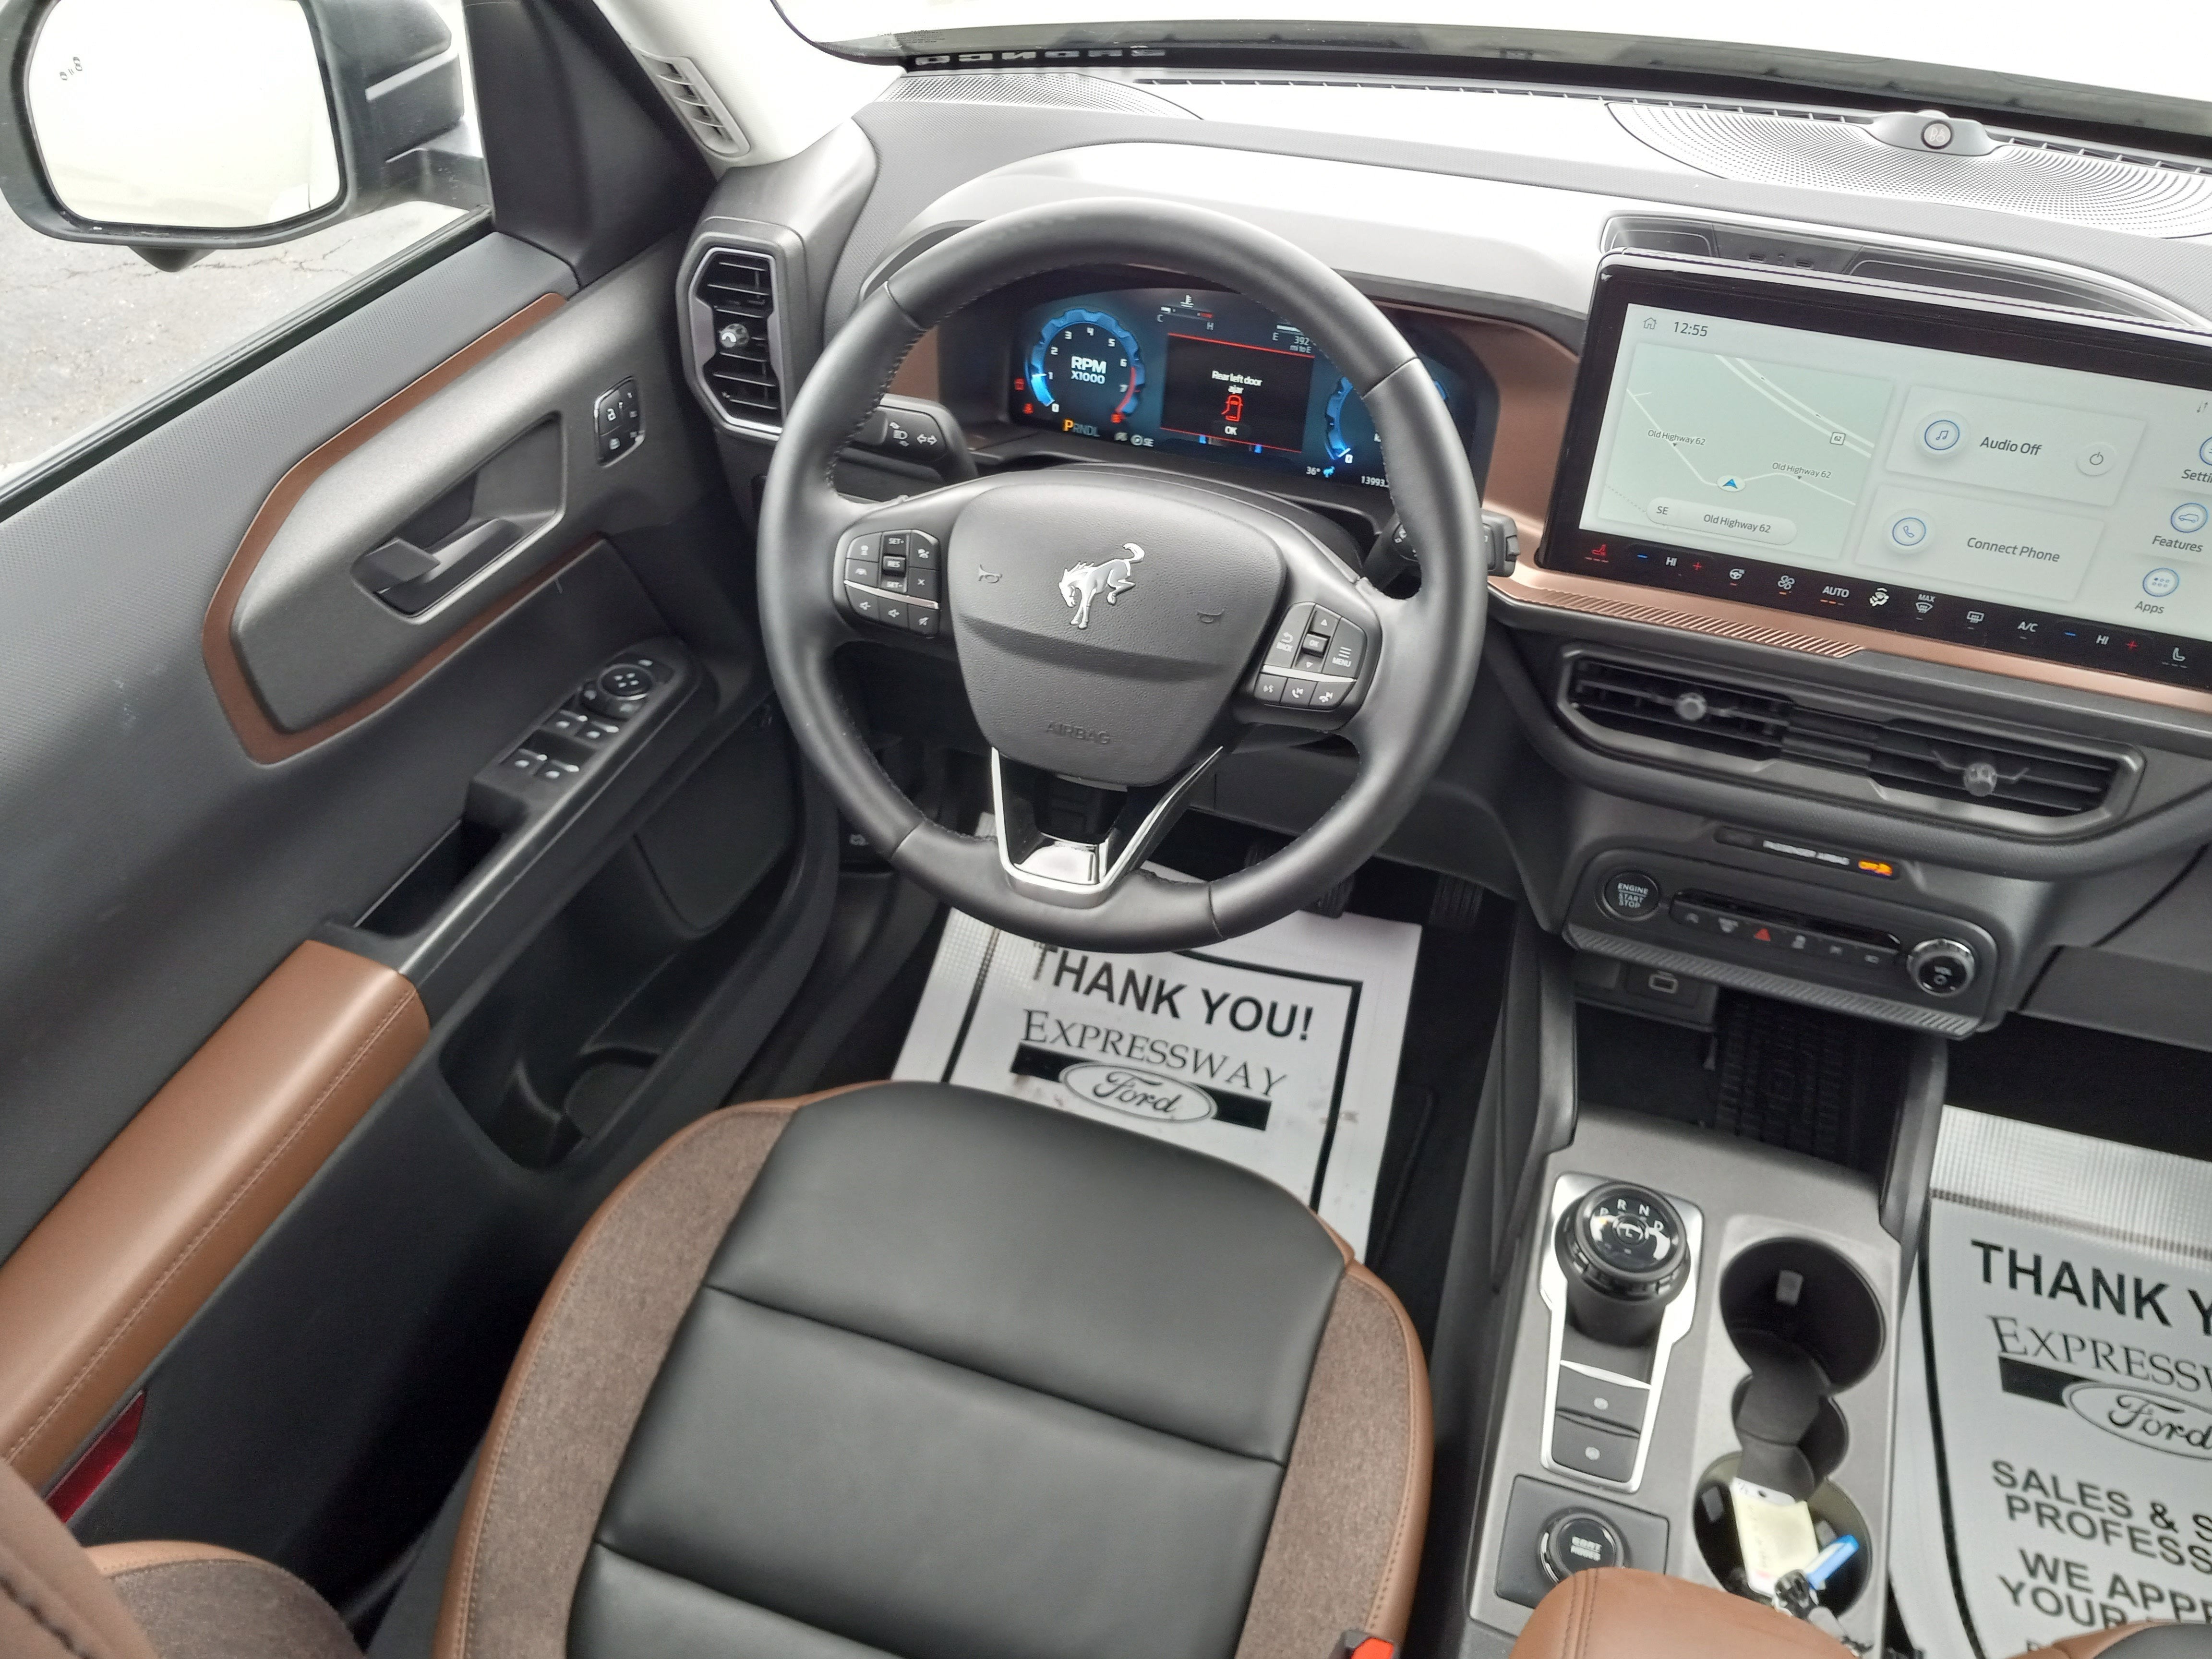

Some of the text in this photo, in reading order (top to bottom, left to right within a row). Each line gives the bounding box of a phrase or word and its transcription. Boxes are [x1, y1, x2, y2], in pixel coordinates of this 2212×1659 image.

[1087, 327, 1094, 336] 4
[1206, 322, 1214, 331] H
[1673, 321, 1709, 337] 12:55
[1064, 331, 1072, 339] 3
[1272, 332, 1279, 341] E
[1294, 336, 1310, 346] 392
[1108, 338, 1116, 347] 5
[1050, 347, 1058, 355] 2
[1071, 356, 1106, 374] RPM
[1120, 359, 1127, 367] 6
[1048, 372, 1053, 380] 1
[1071, 370, 1106, 385] X1000
[1212, 370, 1263, 386] Rear left door
[1119, 384, 1128, 392] 7
[1228, 385, 1244, 394] ajar
[1051, 403, 1059, 412] 0
[1225, 426, 1238, 435] OK
[1648, 430, 1661, 438] Old
[1662, 432, 1695, 445] Highway
[1980, 437, 2042, 456] Audio Off
[1345, 454, 1353, 464] 0
[1772, 462, 1832, 479] Old Highway 62
[1361, 475, 1389, 488] 13993
[1656, 506, 1669, 515] SE
[1703, 514, 1771, 533] Old Highway 62
[1967, 537, 2060, 562] Connect Phone
[2152, 536, 2203, 553] Features
[1822, 586, 1850, 598] AUTO
[1918, 594, 1936, 603] MAX
[2135, 601, 2164, 614] Apps
[2018, 621, 2038, 633] A/C
[1332, 657, 1351, 667] MENU
[1618, 883, 1648, 895] ENGINE
[1033, 942, 1313, 1041] THANK YOU!
[1022, 1009, 1287, 1096] EXPRESSWAY
[1093, 1070, 1182, 1112] Ford
[1639, 1204, 1650, 1216] N
[1971, 1238, 2172, 1328] THANK
[1985, 1314, 2212, 1392] EXPRESS
[1992, 1459, 2133, 1519] SALES
[2149, 1501, 2179, 1534] &
[2006, 1493, 2212, 1575] PROFESS
[2019, 1548, 2093, 1594] WE
[1997, 1574, 2128, 1629] YOUR
